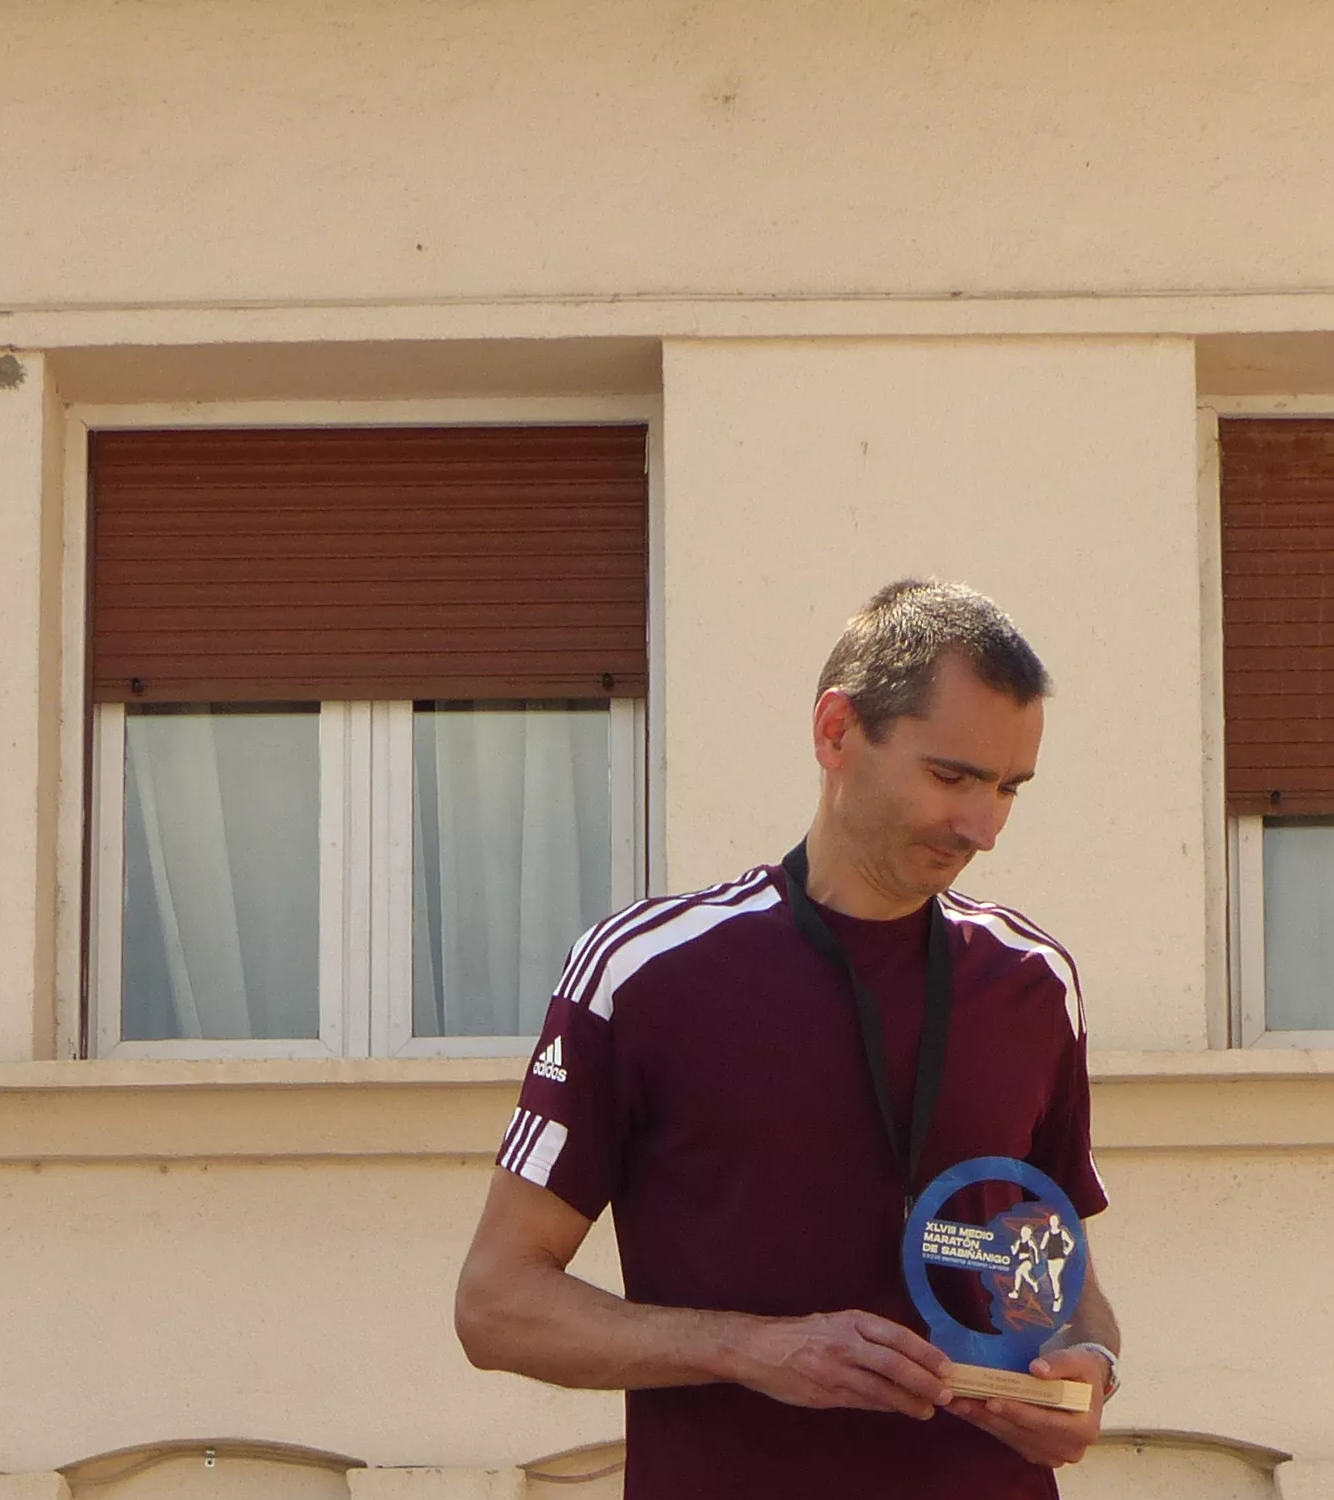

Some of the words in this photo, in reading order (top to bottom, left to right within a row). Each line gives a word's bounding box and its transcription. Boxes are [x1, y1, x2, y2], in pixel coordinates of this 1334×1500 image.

[532, 1061, 567, 1082] adidas
[923, 1231, 980, 1249] MARATÓN
[959, 1227, 994, 1241] MEDIO
[922, 1243, 939, 1254] DE
[941, 1245, 1011, 1265] SABIÑÁNIGO
